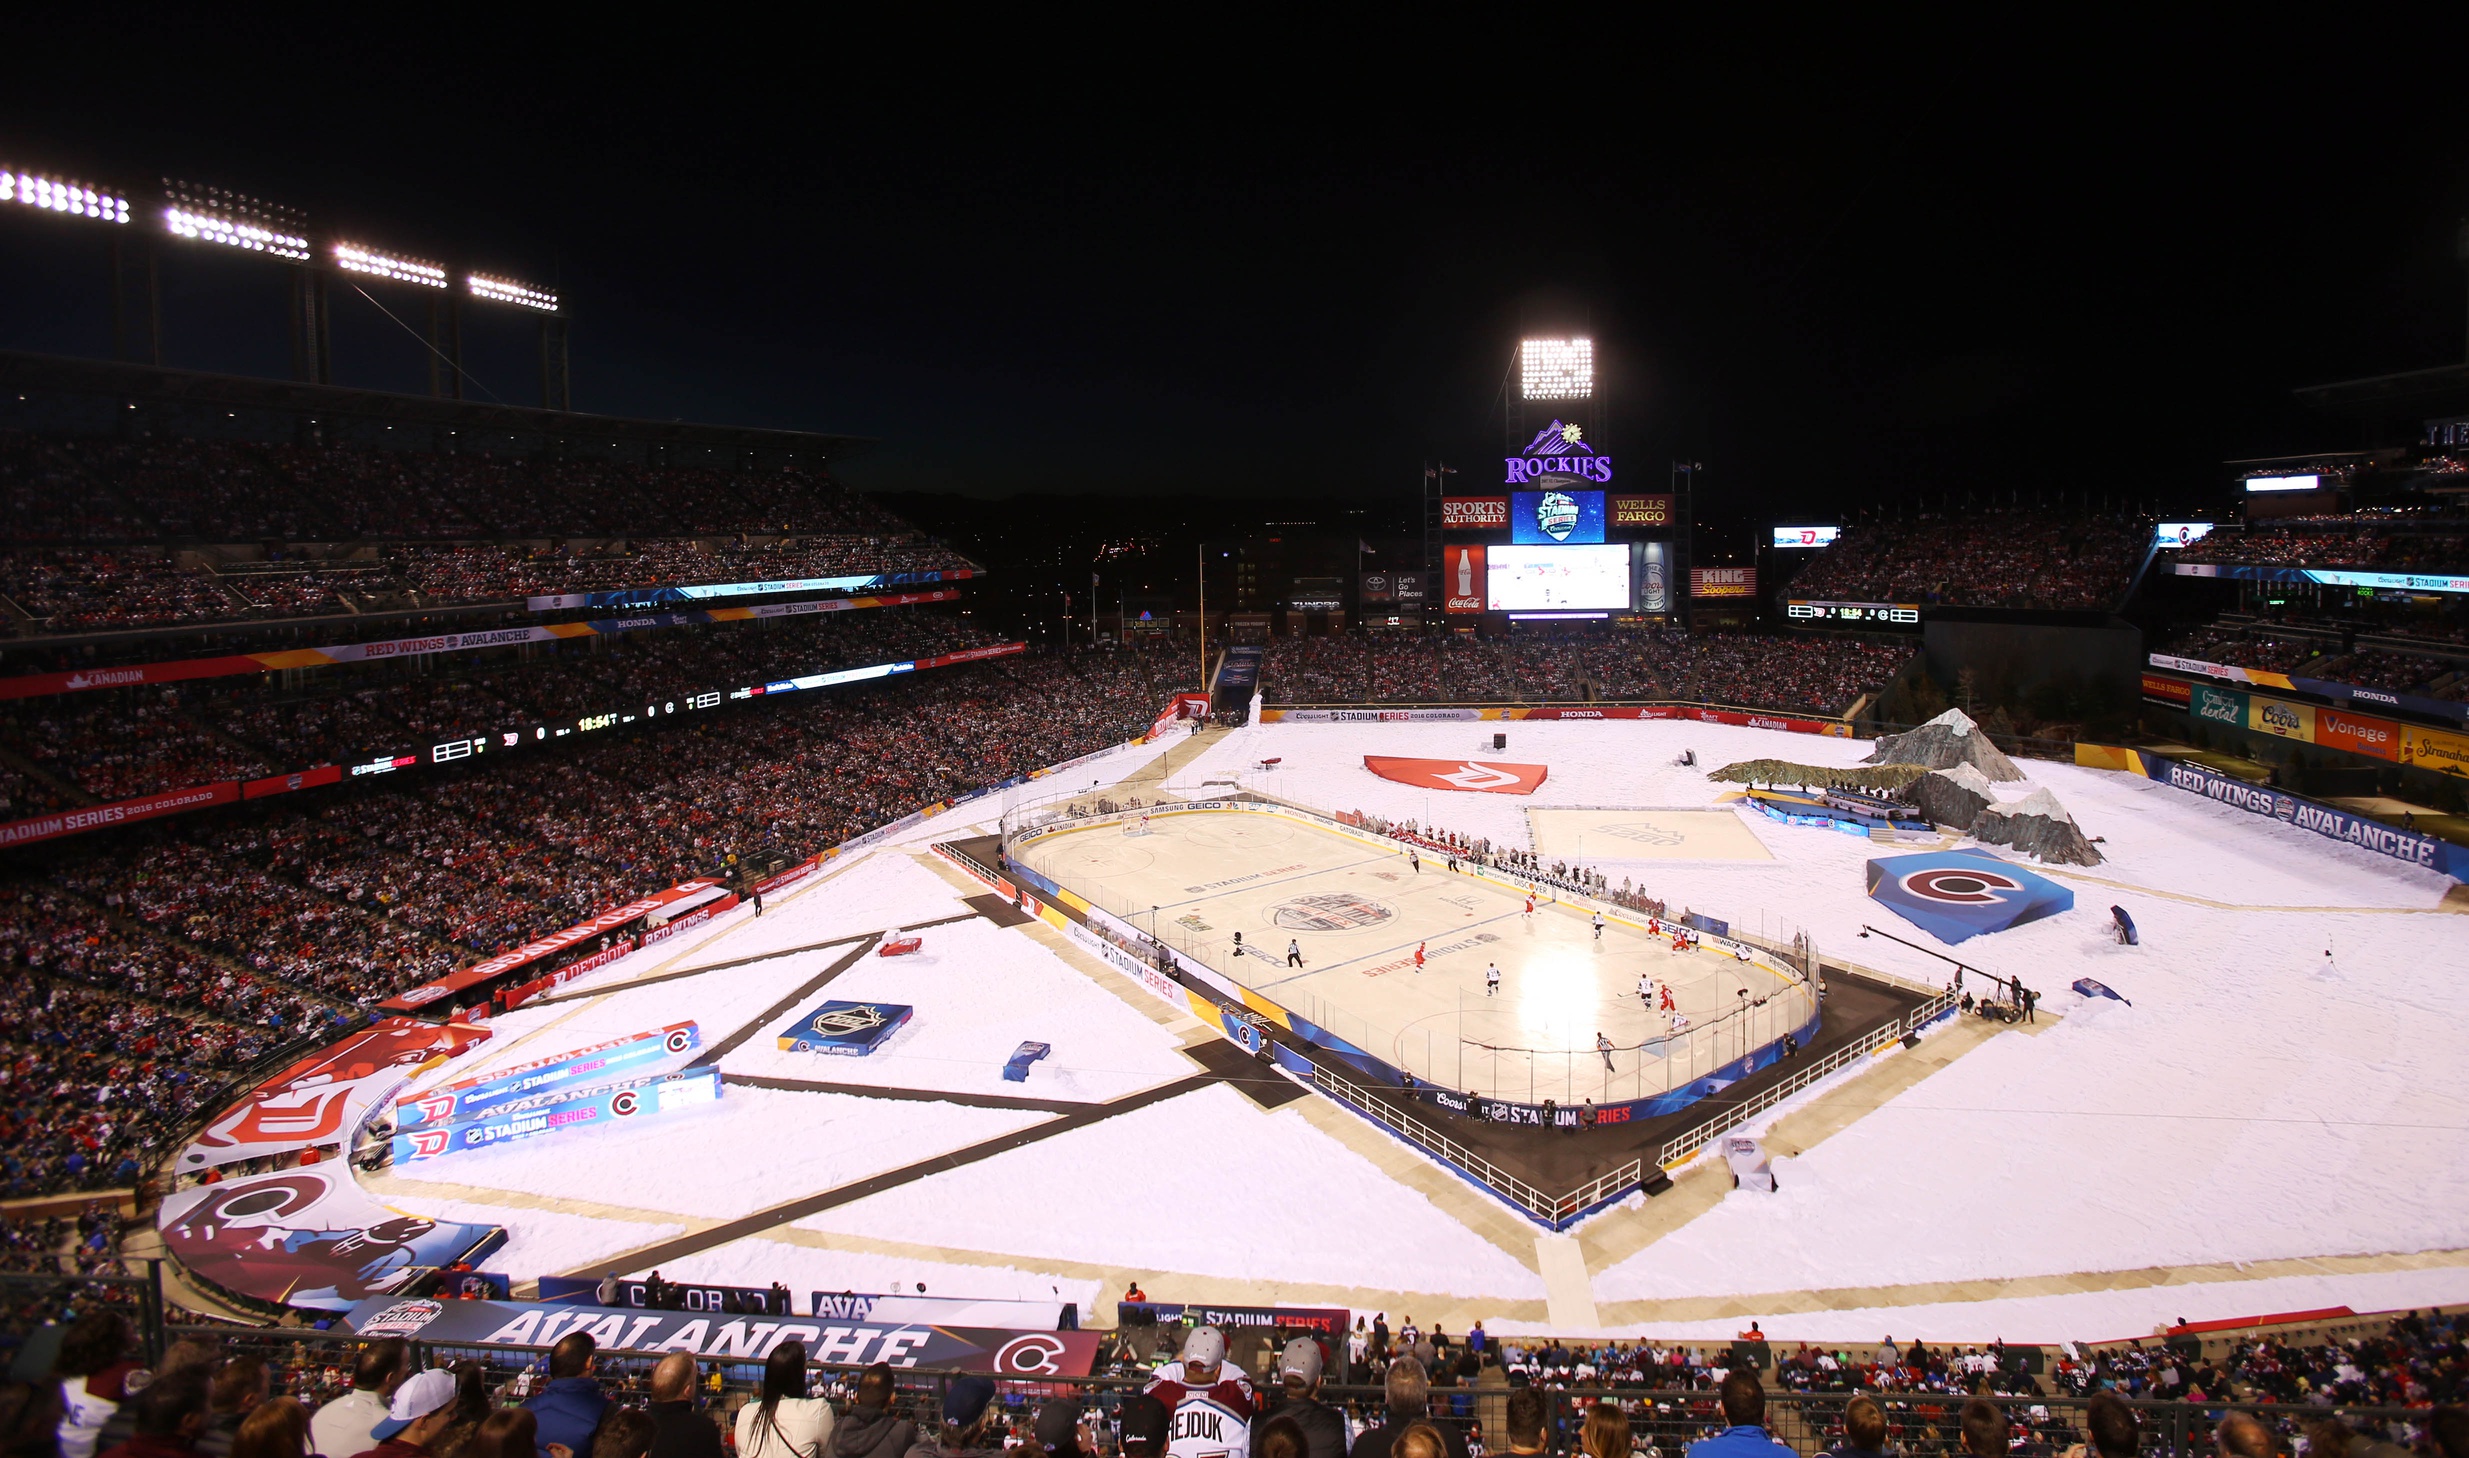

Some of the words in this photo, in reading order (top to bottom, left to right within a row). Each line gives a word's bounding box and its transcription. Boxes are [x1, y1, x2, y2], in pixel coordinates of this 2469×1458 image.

[1505, 456, 1612, 483] ROCKIES
[1443, 501, 1506, 515] SPORTS
[1616, 500, 1665, 510] WELLS
[1617, 511, 1665, 521] FARGO
[1702, 570, 1744, 583] KING
[2415, 577, 2448, 588] STADIUM
[764, 583, 785, 591] STADIUM
[785, 581, 803, 590] SERIES
[1702, 583, 1746, 597] Soopers
[792, 603, 818, 613] STADIUM
[818, 602, 838, 611] SERIES
[617, 618, 656, 628] HONDA
[365, 642, 397, 657] RED
[399, 637, 445, 653] WINGS
[461, 629, 530, 646] AVALANCHE
[2181, 660, 2207, 673] STADIUM
[2207, 665, 2229, 677] SERIES
[87, 670, 144, 686] CANADIAN
[2142, 679, 2165, 692] WELLS
[2166, 684, 2190, 697] FARGO
[2352, 690, 2399, 704] HONDA
[1341, 711, 1378, 721] STADIUM
[2201, 703, 2239, 723] dental
[2262, 704, 2301, 729] Coors
[578, 714, 610, 732] 18:54
[1757, 717, 1787, 731] CANADIAN
[2325, 715, 2388, 743] Vonage
[392, 755, 416, 767] SERIES
[66, 806, 125, 830] SERIES
[127, 803, 153, 815] 2016
[155, 791, 214, 809] COLORADO
[1151, 804, 1184, 814] SAMSUNG
[1187, 801, 1221, 810] GEICO
[1284, 808, 1308, 820] HONDA
[2168, 764, 2205, 792] RED
[2203, 777, 2273, 817] WINGS
[2294, 804, 2435, 868] AVALANCHE
[866, 830, 885, 843] STADIUM
[885, 823, 899, 835] SERIES
[1019, 828, 1043, 843] GEICO
[1054, 822, 1076, 832] CANADIAN
[1339, 825, 1365, 838] GATORADE
[780, 870, 801, 884] STADIUM
[800, 862, 816, 875] SERIES
[1204, 873, 1264, 890] STADIUM
[1264, 864, 1307, 878] SERIES
[645, 926, 672, 946] RED
[671, 909, 710, 932] WINGS
[569, 940, 632, 980] DETROIT
[1769, 956, 1791, 974] Reebok
[1109, 946, 1143, 981] STADIUM
[1144, 968, 1174, 999] SERIES
[814, 1044, 859, 1056] AVALANCHE
[522, 1067, 569, 1090] STADIUM
[569, 1058, 606, 1076] SERIES
[474, 1077, 652, 1120] AVALANCHE
[484, 1116, 547, 1142] STADIUM
[548, 1106, 597, 1128] SERIES
[1510, 1106, 1577, 1126] STAUM
[373, 1311, 436, 1323] STADIUM
[1206, 1310, 1274, 1327] STADIUM
[1275, 1316, 1332, 1331] SERIES
[476, 1304, 932, 1369] AVALANCHE
[1168, 1411, 1223, 1443] HEJDUK
